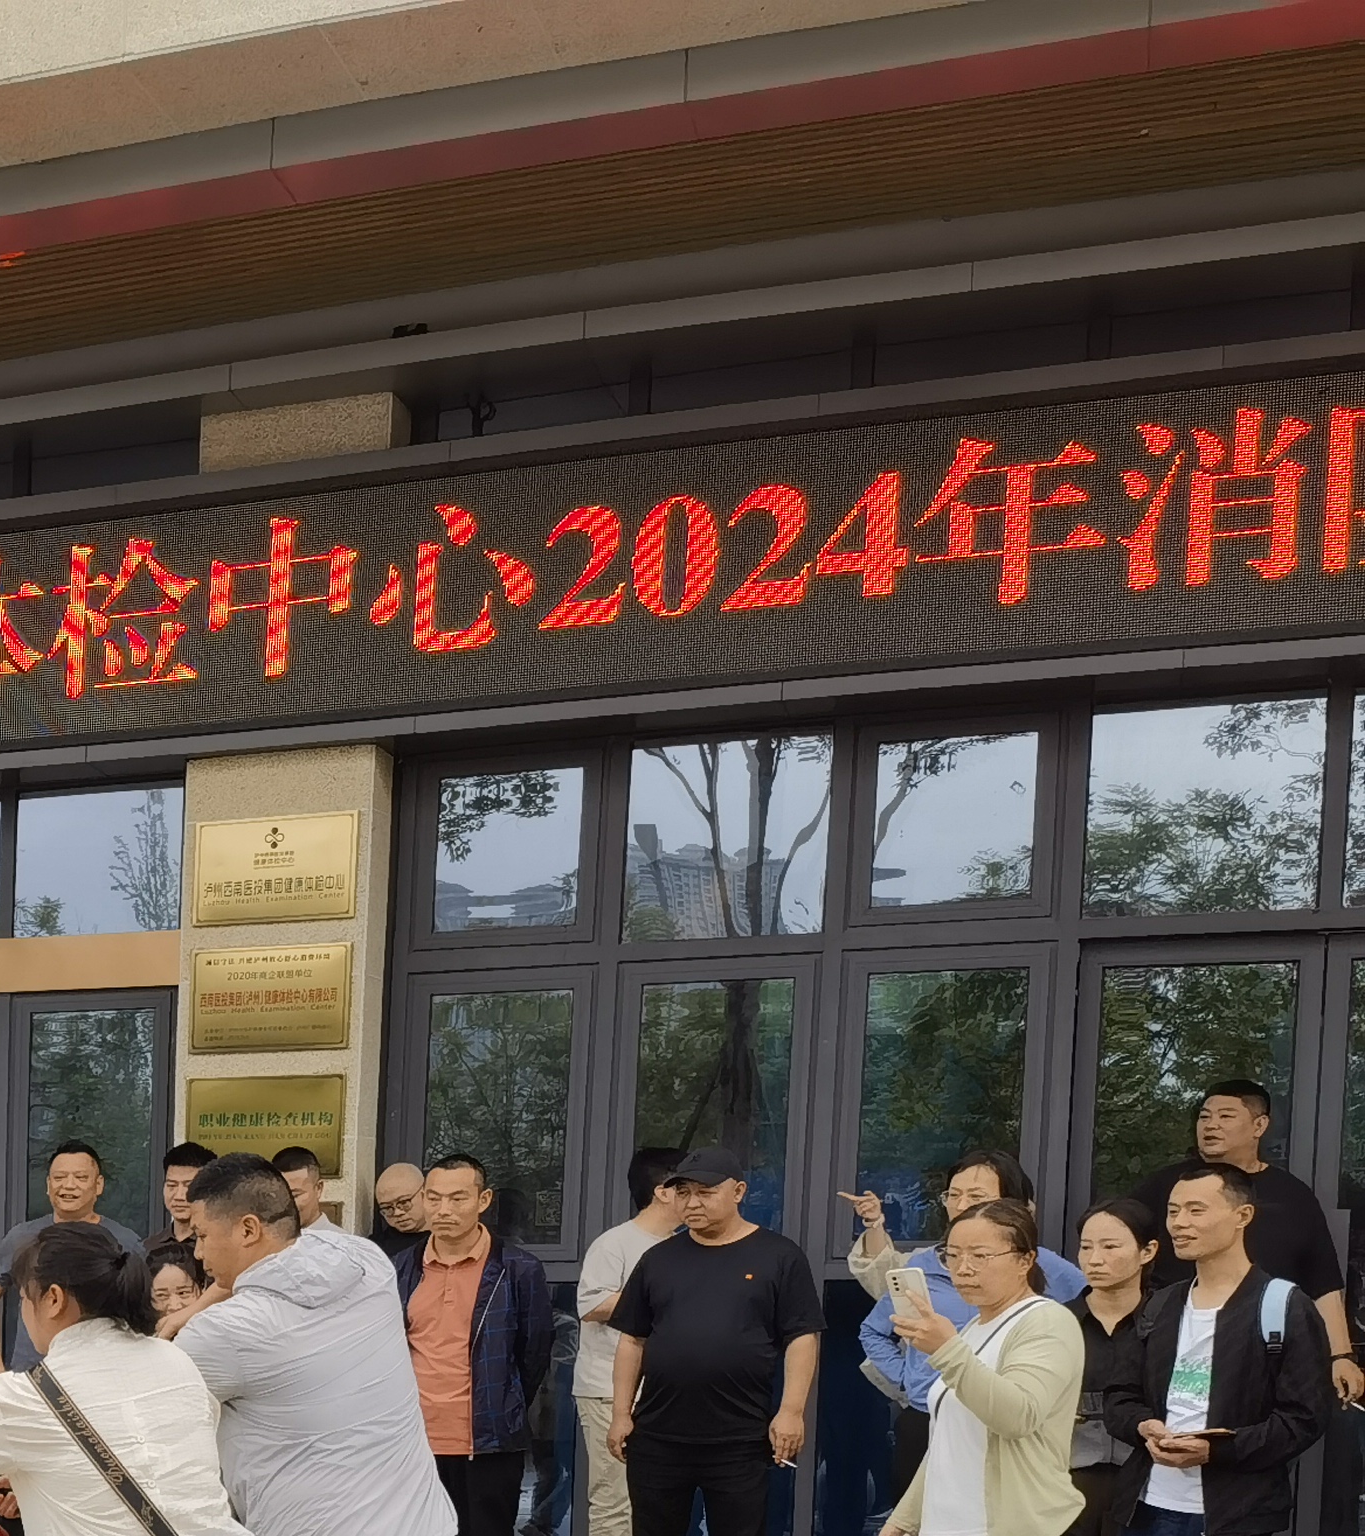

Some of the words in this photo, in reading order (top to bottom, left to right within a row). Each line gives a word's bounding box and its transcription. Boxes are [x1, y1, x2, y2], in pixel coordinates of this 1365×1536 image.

[204, 873, 345, 898] 泸州西南医投集团健康体检中心
[266, 894, 313, 903] Examination
[319, 891, 344, 899] Center
[198, 1112, 334, 1128] 职业健康检查机构
